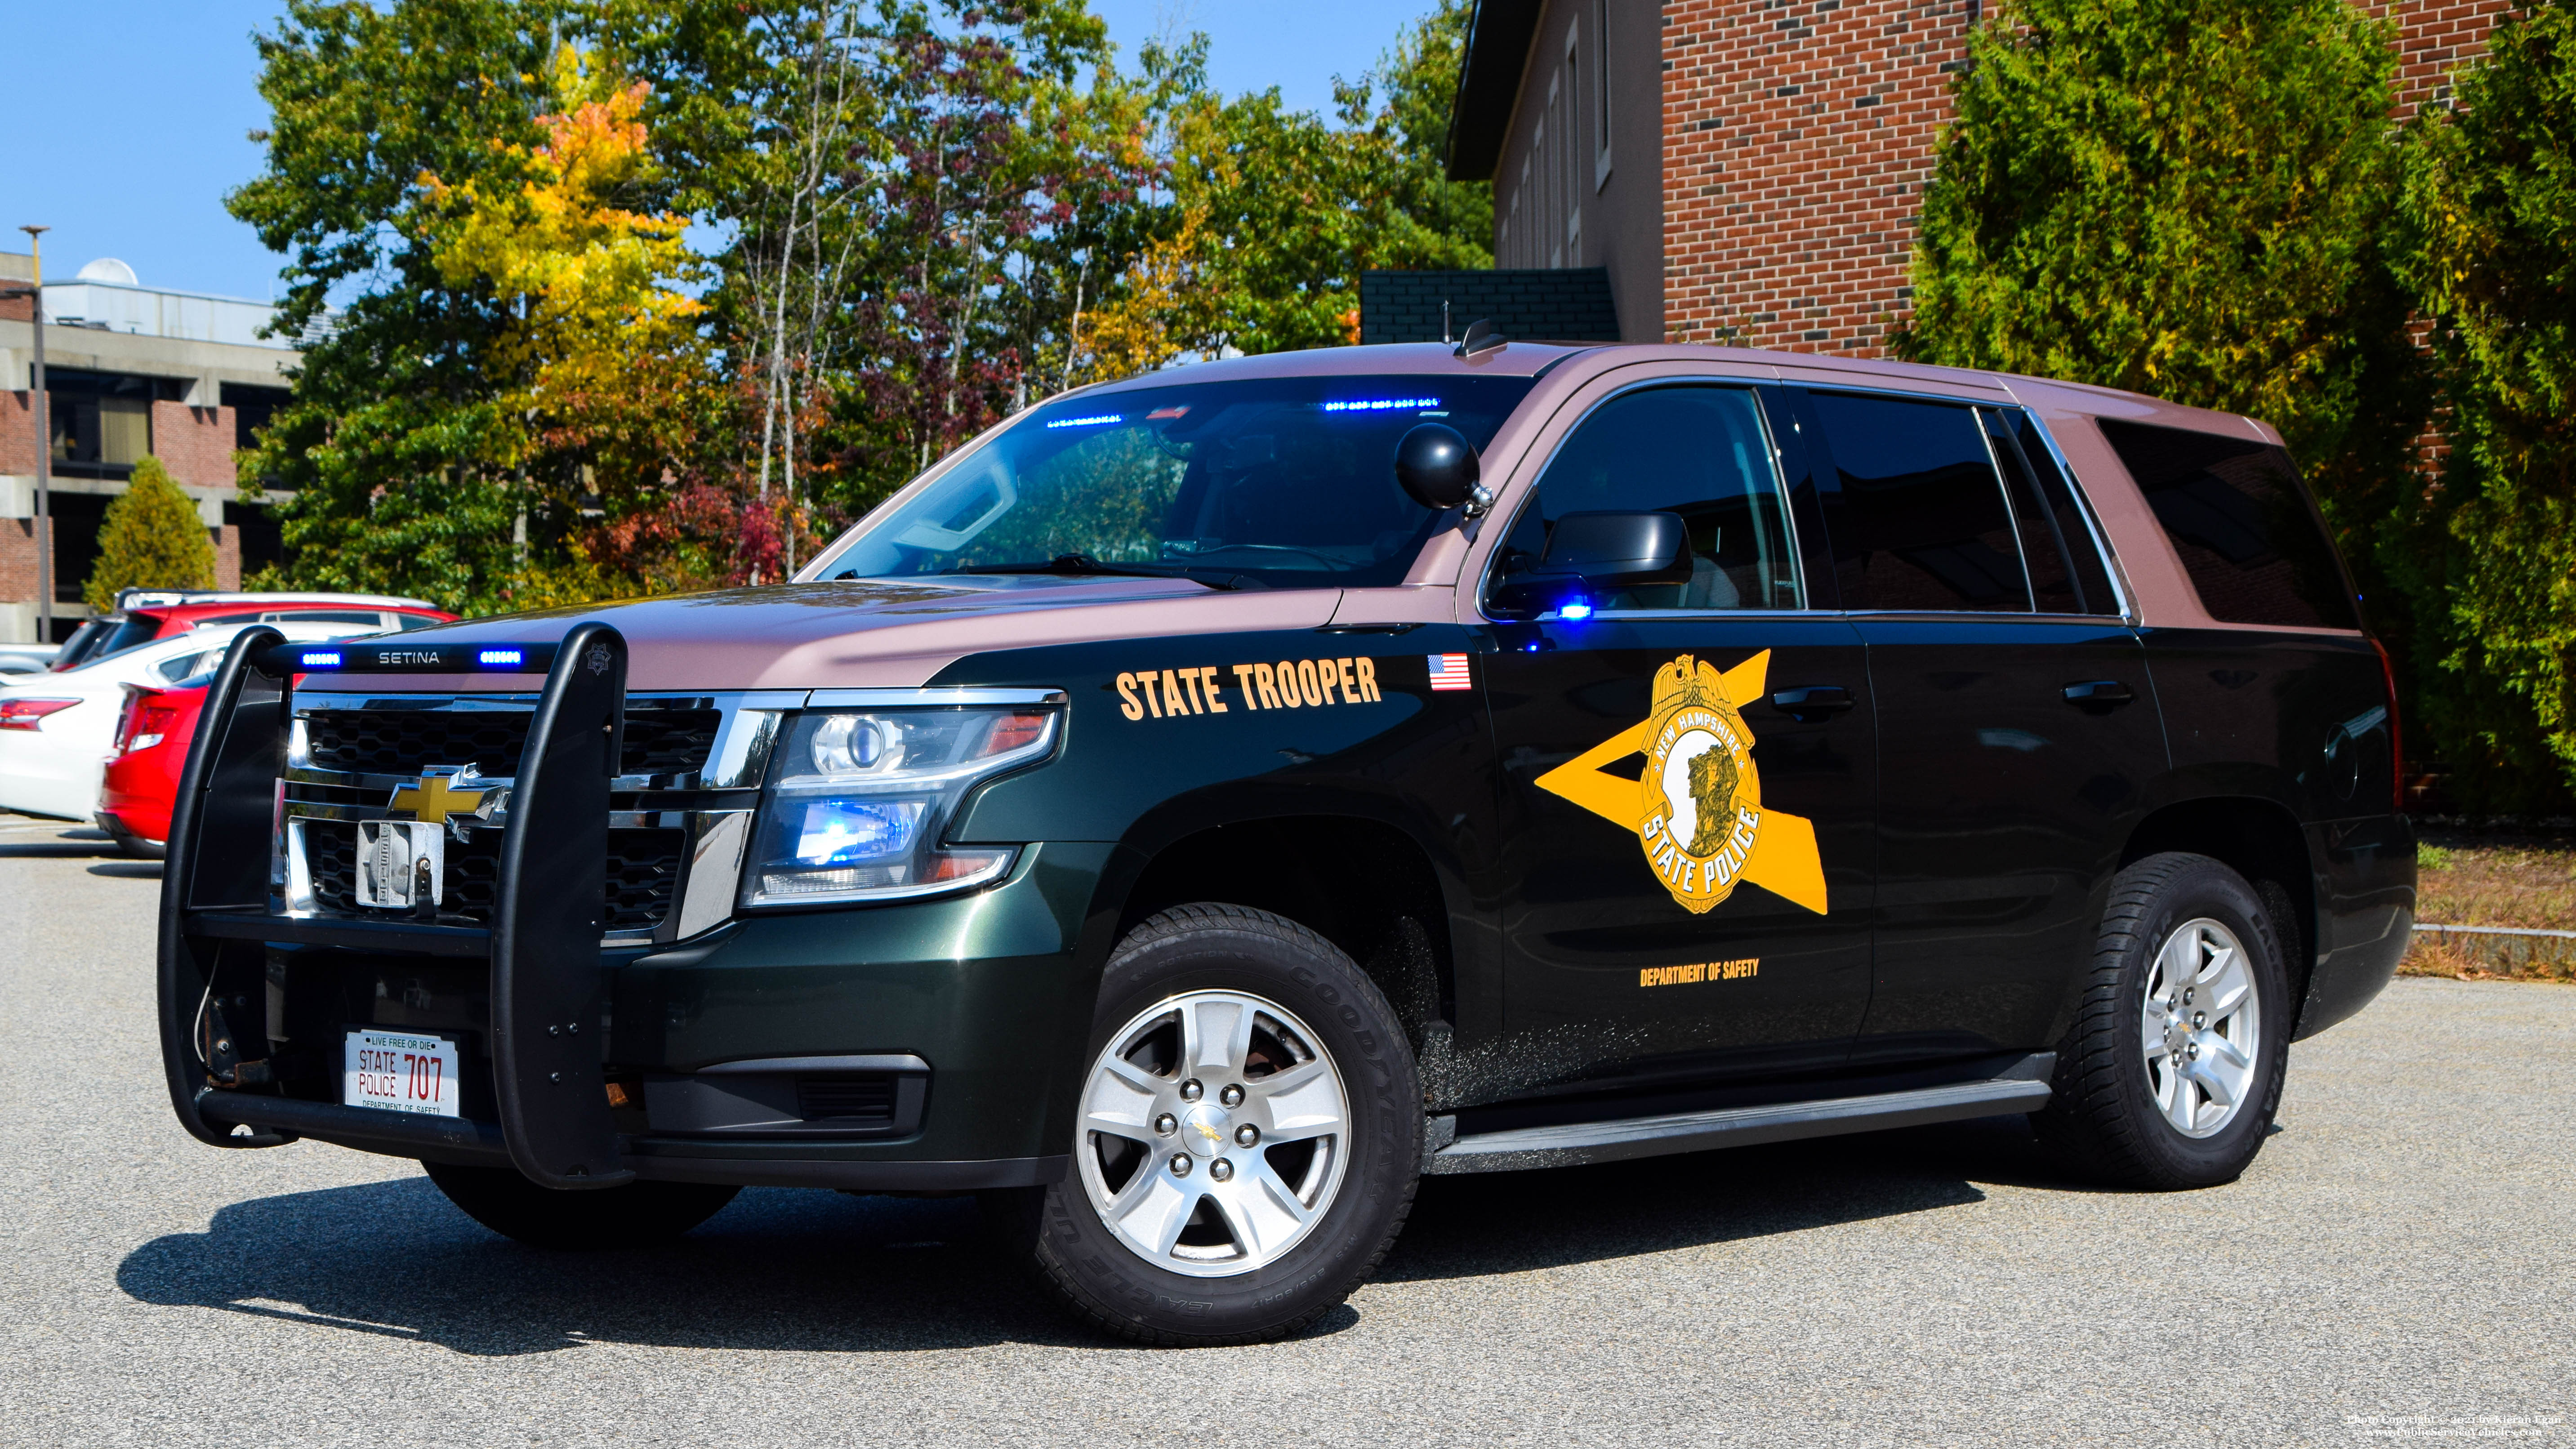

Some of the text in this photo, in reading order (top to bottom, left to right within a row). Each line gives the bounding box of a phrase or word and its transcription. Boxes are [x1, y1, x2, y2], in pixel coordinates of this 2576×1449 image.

[379, 652, 440, 664] SETINA
[1115, 656, 1382, 721] STATE TROOPER
[1655, 712, 1741, 760] NEW HAMPSHIRE
[1644, 805, 1761, 894] STATE POLICE
[1640, 958, 1760, 987] DEPARTMENT OF SAFETY
[372, 1037, 431, 1050] LIVE FREE OR DIE
[360, 1050, 397, 1073] STATE
[360, 1073, 397, 1097] POLICE
[404, 1054, 442, 1102] 707
[362, 1100, 401, 1110] DEPARTMENT
